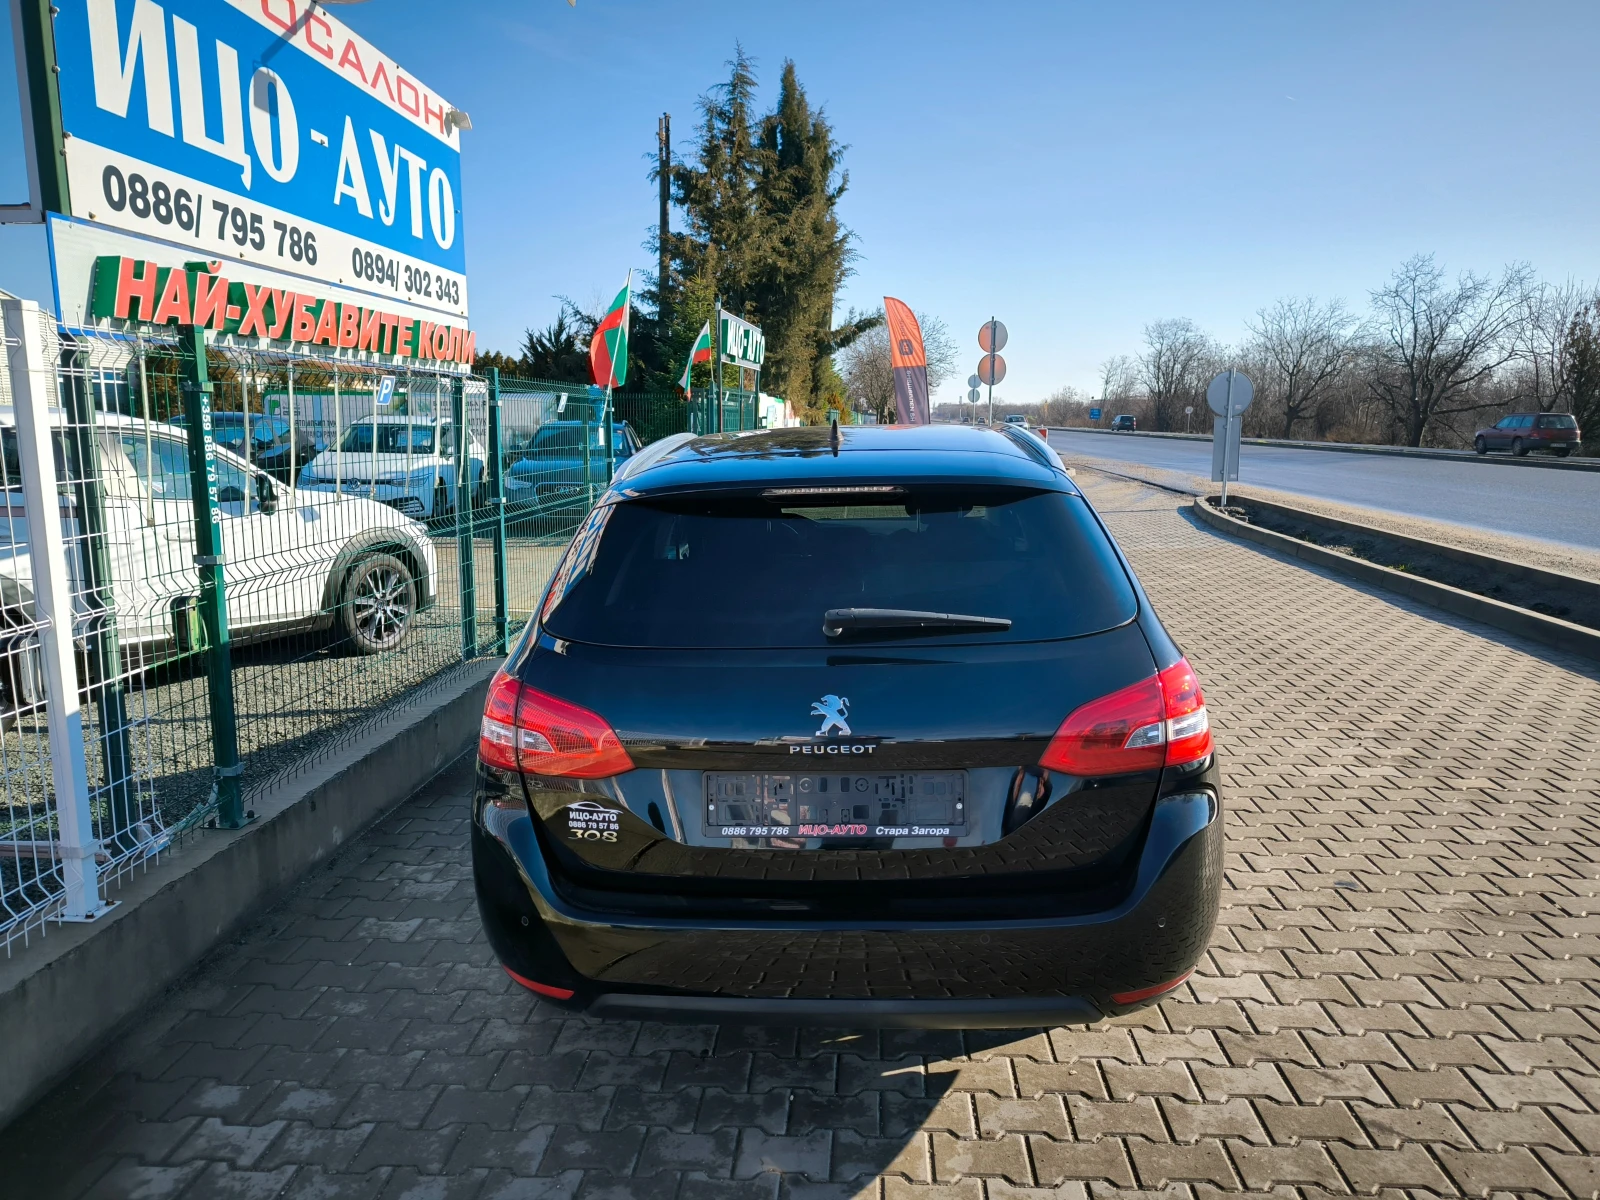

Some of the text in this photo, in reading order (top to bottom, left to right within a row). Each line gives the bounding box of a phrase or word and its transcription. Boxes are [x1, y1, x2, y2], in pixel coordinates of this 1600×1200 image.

[212, 199, 265, 251] 795
[273, 219, 318, 266] 786
[404, 264, 432, 298] 302
[435, 275, 460, 305] 343
[113, 256, 476, 366] НАЙ-ХУБАВИТЕ КОЛИ
[202, 396, 221, 524] +359 886 79 57 86
[789, 744, 877, 754] PEUGEOT
[569, 811, 617, 821] ИЦО-АУТО
[568, 828, 618, 843] 308
[721, 826, 789, 836] 0886 795 786
[798, 824, 868, 837] ИЦО-АУТО
[875, 826, 950, 837] Стара Загора
